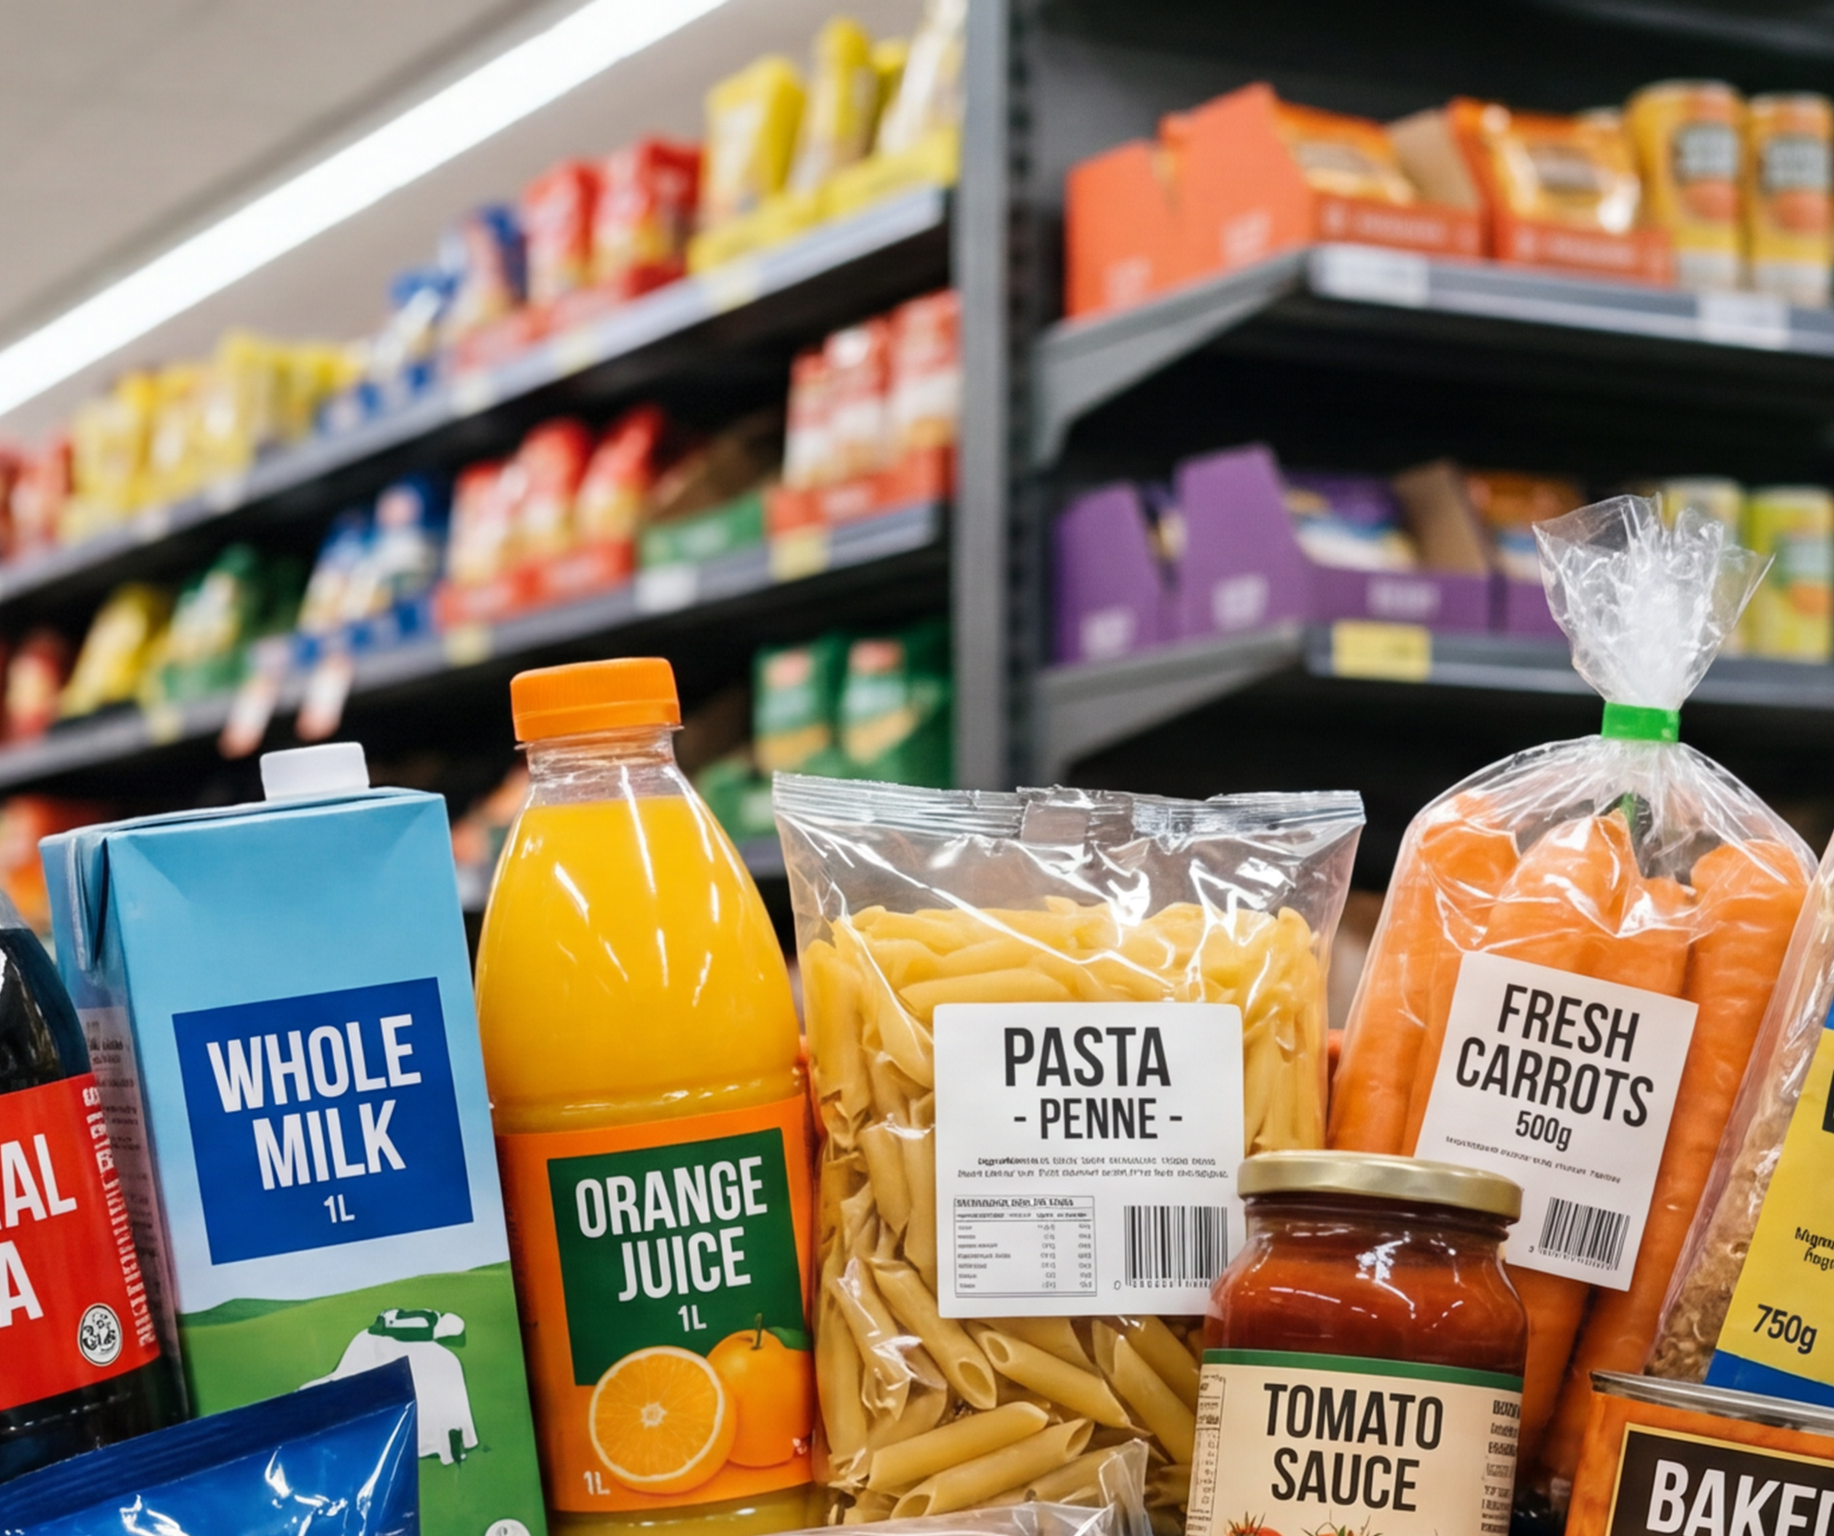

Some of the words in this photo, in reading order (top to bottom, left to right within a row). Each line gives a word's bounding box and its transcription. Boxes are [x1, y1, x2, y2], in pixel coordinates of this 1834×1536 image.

[1498, 984, 1639, 1062] FRESH
[207, 1014, 421, 1112] WHOLE
[1005, 1027, 1171, 1086] PASTA
[1457, 1037, 1653, 1127] CARROTS
[253, 1100, 405, 1190] MILK
[1041, 1098, 1157, 1139] PENNE
[1516, 1111, 1572, 1152] 500g
[324, 1195, 355, 1223] 1L
[576, 1156, 767, 1237] ORANGE
[619, 1227, 751, 1301] JUICE
[678, 1305, 706, 1331] 1L
[1754, 1304, 1817, 1354] 750g
[1264, 1383, 1443, 1450] TOMATO
[1272, 1448, 1419, 1511] SAUCE
